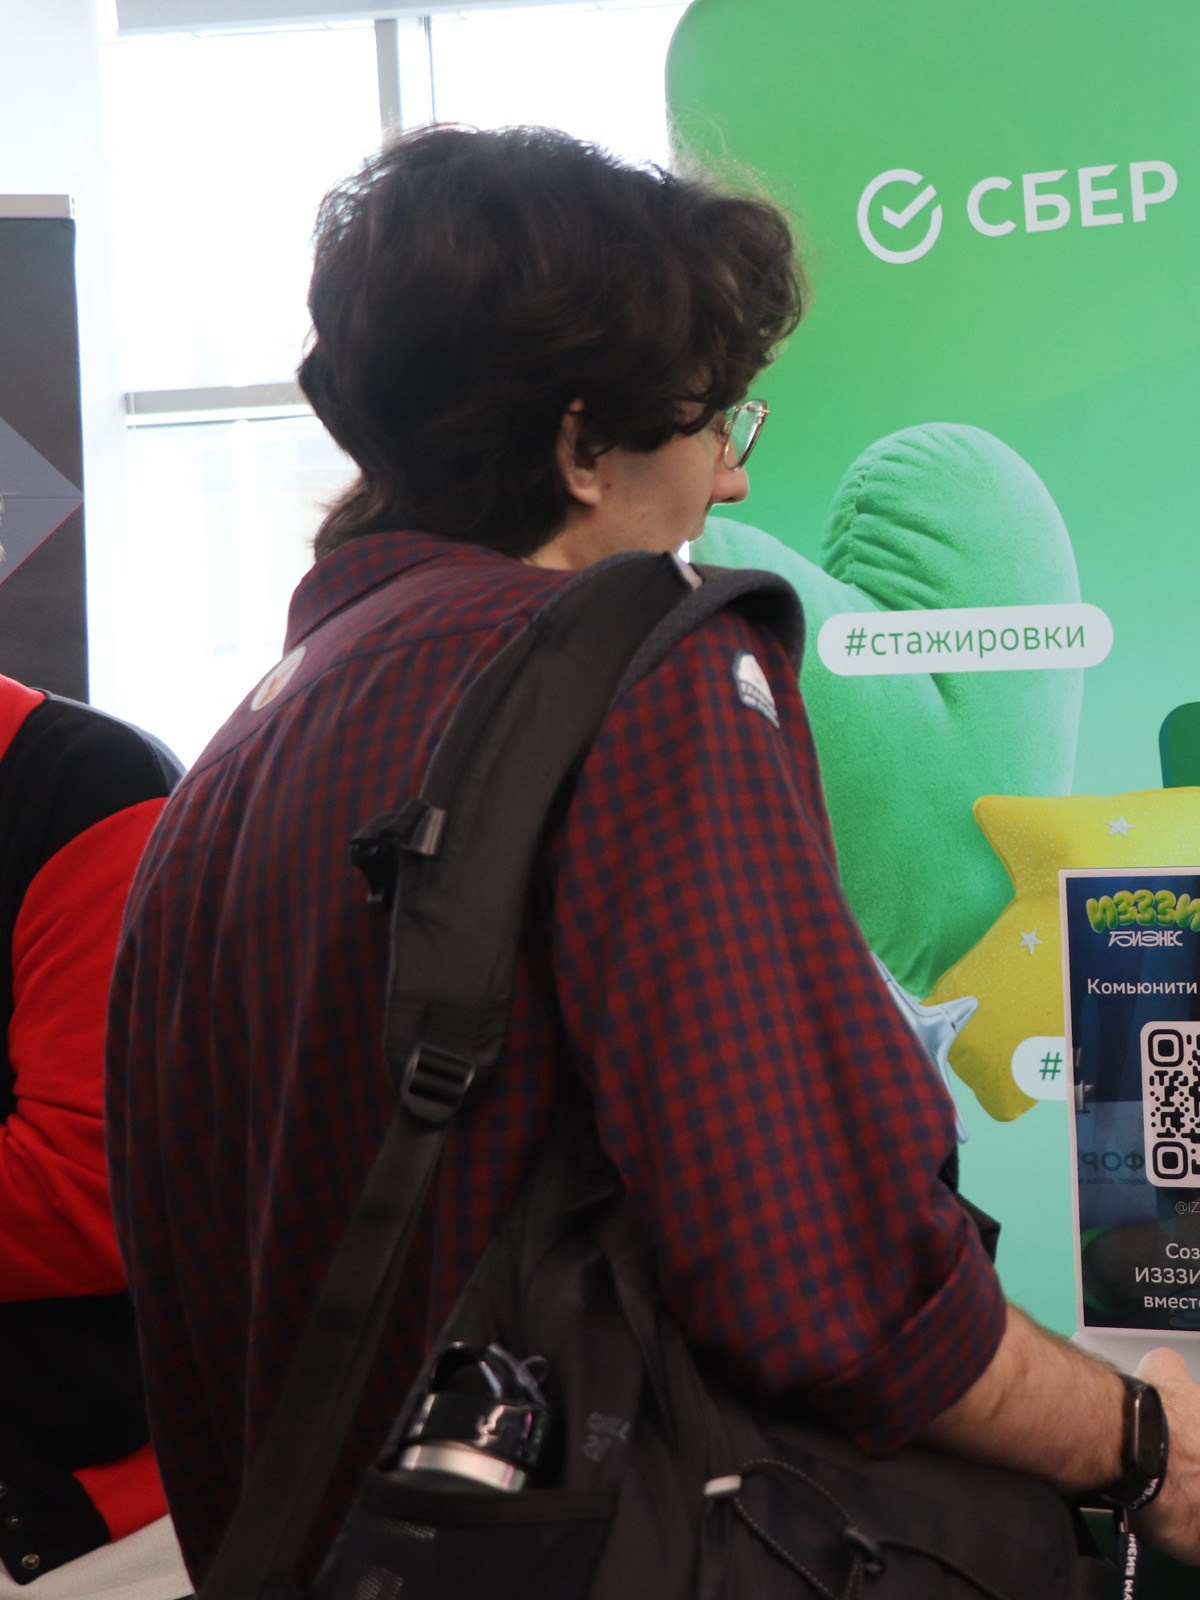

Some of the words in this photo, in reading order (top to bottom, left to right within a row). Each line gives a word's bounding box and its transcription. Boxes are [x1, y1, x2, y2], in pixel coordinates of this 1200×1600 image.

[967, 160, 1179, 238] СБЕР
[844, 624, 1086, 659] #стажировки
[1108, 930, 1184, 948] БИЗНЕС
[1087, 977, 1199, 995] Комьюнити
